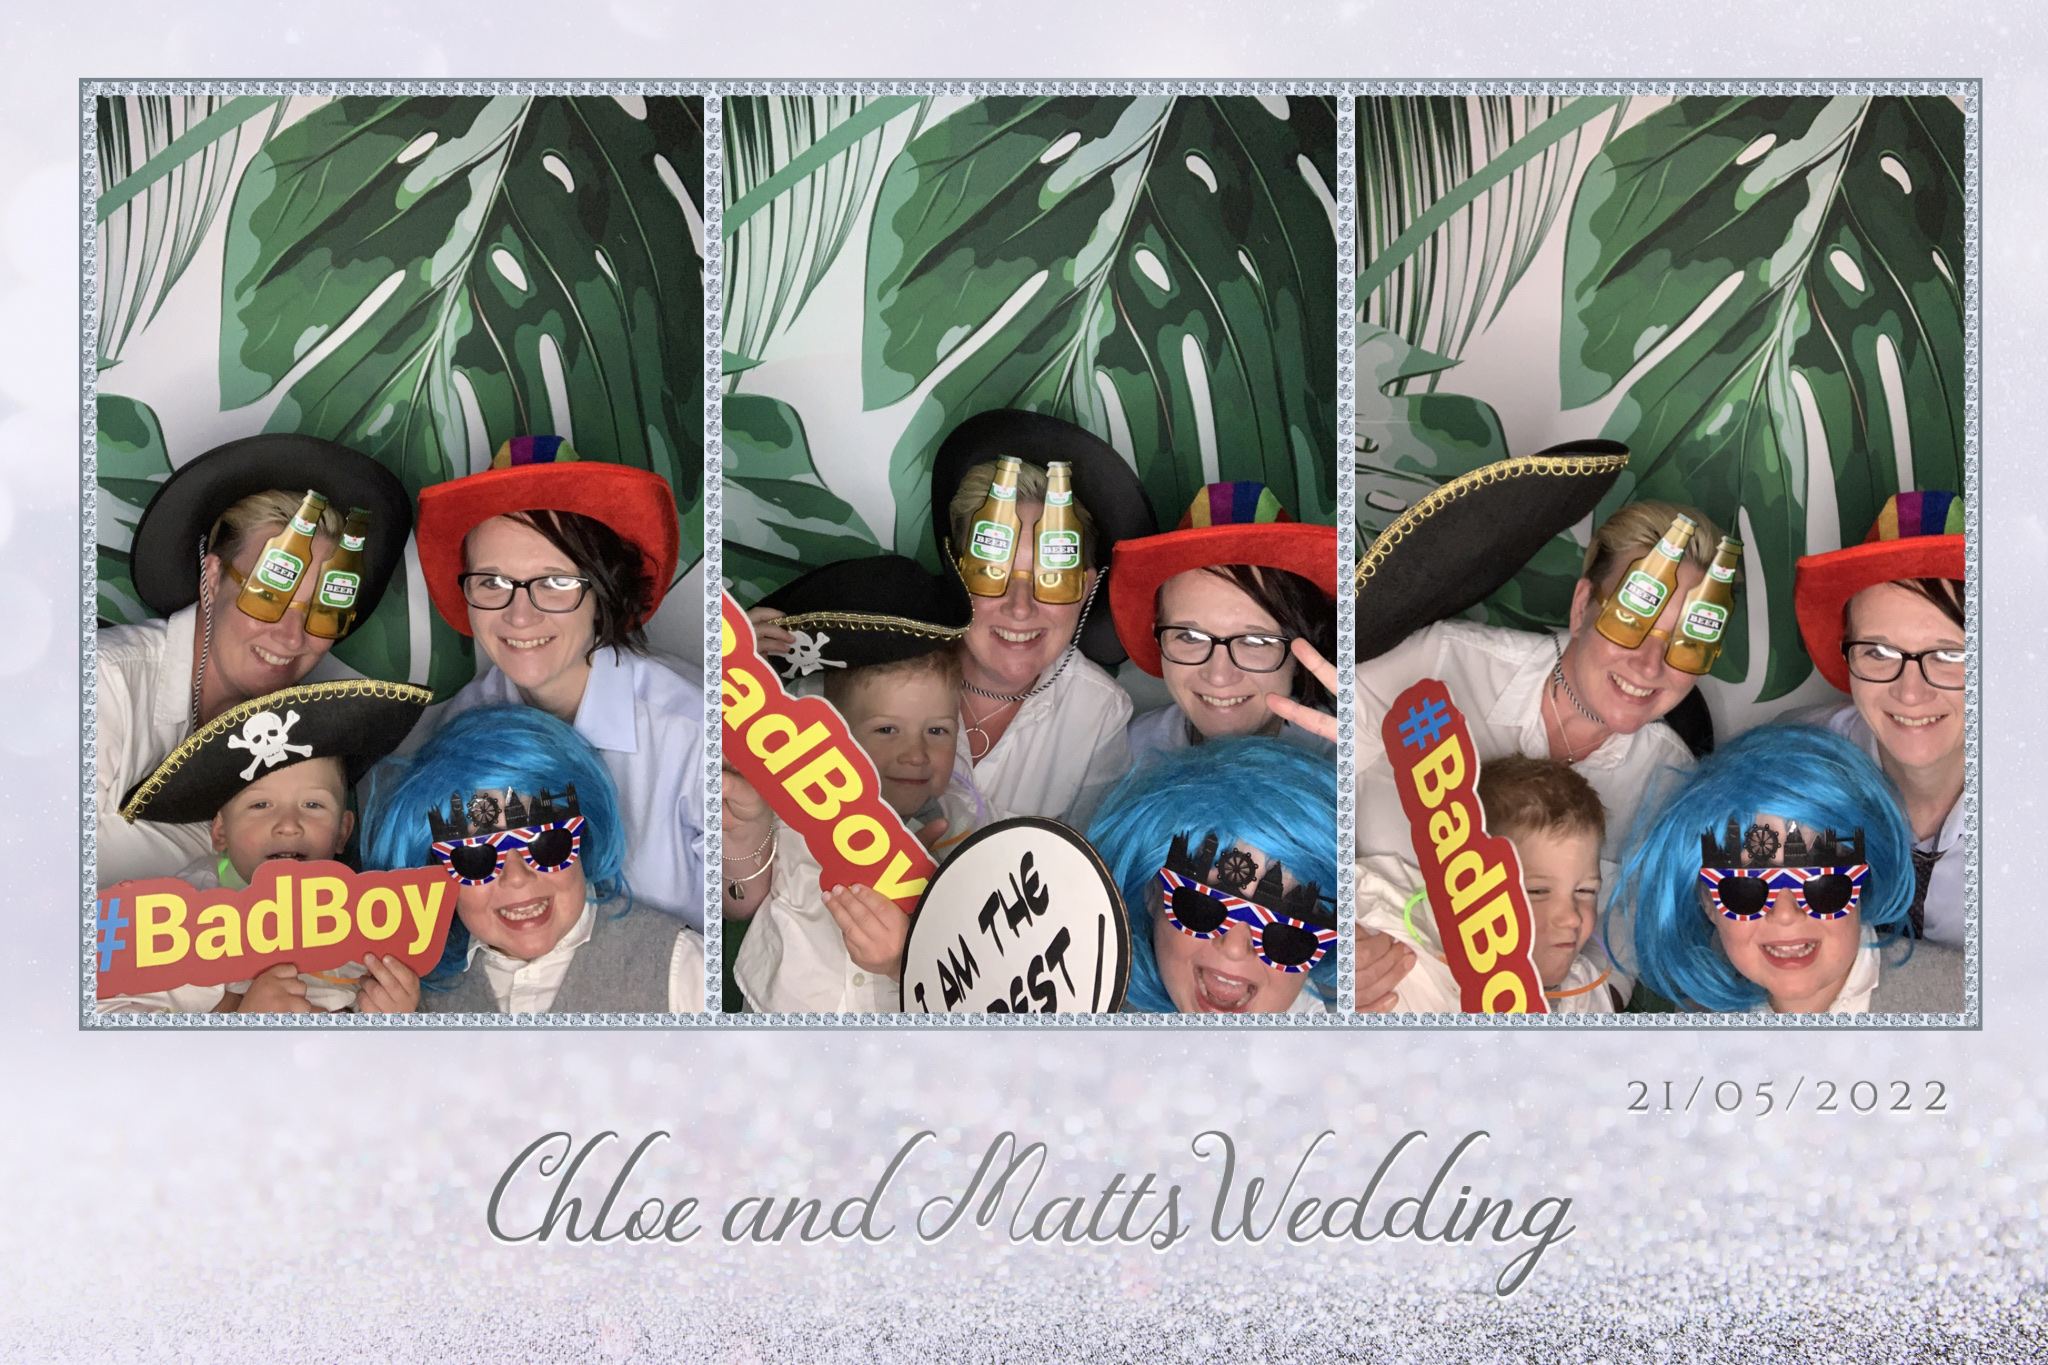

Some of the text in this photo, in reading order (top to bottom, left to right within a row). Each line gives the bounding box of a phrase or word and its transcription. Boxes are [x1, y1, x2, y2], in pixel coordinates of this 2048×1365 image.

[976, 534, 1008, 549] BEER
[1043, 546, 1076, 554] BEER
[265, 560, 296, 580] BEER
[325, 583, 355, 596] BEER
[1627, 583, 1658, 606] BEER
[1689, 614, 1720, 630] BEER
[722, 616, 929, 900] adBoy
[96, 875, 447, 973] #BadBoy
[936, 933, 981, 1012] AM
[977, 850, 1050, 958] THE
